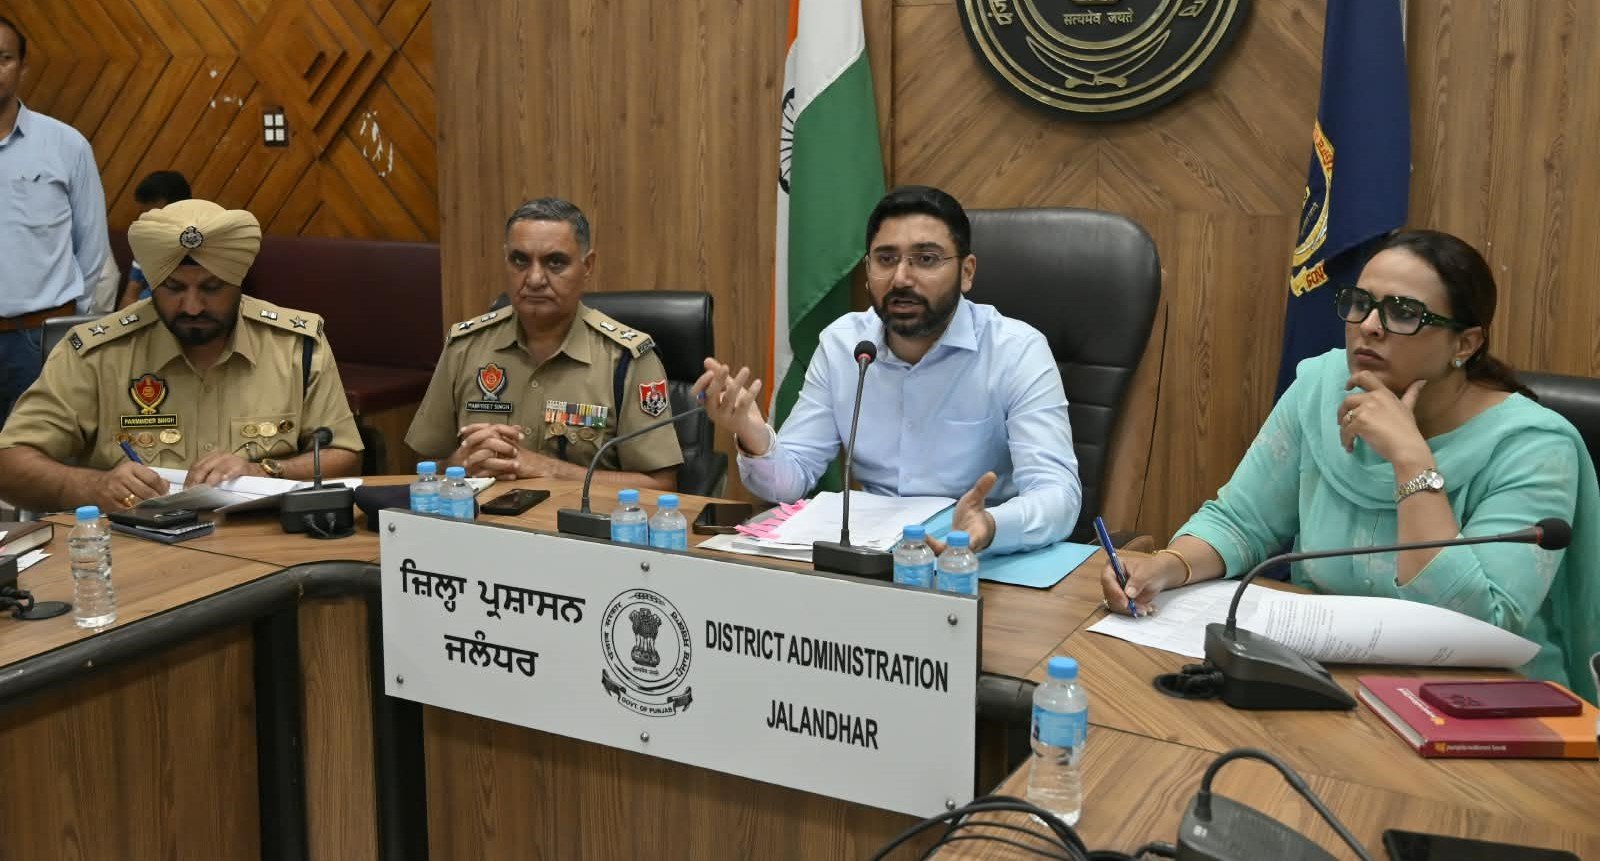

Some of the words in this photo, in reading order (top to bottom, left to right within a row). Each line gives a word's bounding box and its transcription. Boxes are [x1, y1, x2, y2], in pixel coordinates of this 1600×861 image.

[1063, 12, 1101, 26] सत्यमेव
[1108, 8, 1134, 24] जयते
[400, 558, 467, 612] ਜ਼ਿਲ੍ਹਾ
[478, 580, 586, 623] ਪ੍ਰਸ਼ਾਸਨ
[444, 630, 539, 677] ਜਲੰਧਰ
[706, 620, 784, 662] DISTRICT
[787, 635, 948, 693] ADMINISTRATION
[639, 705, 648, 713] OF
[649, 706, 673, 714] PUNJAB
[767, 700, 878, 750] JALANDHAR
